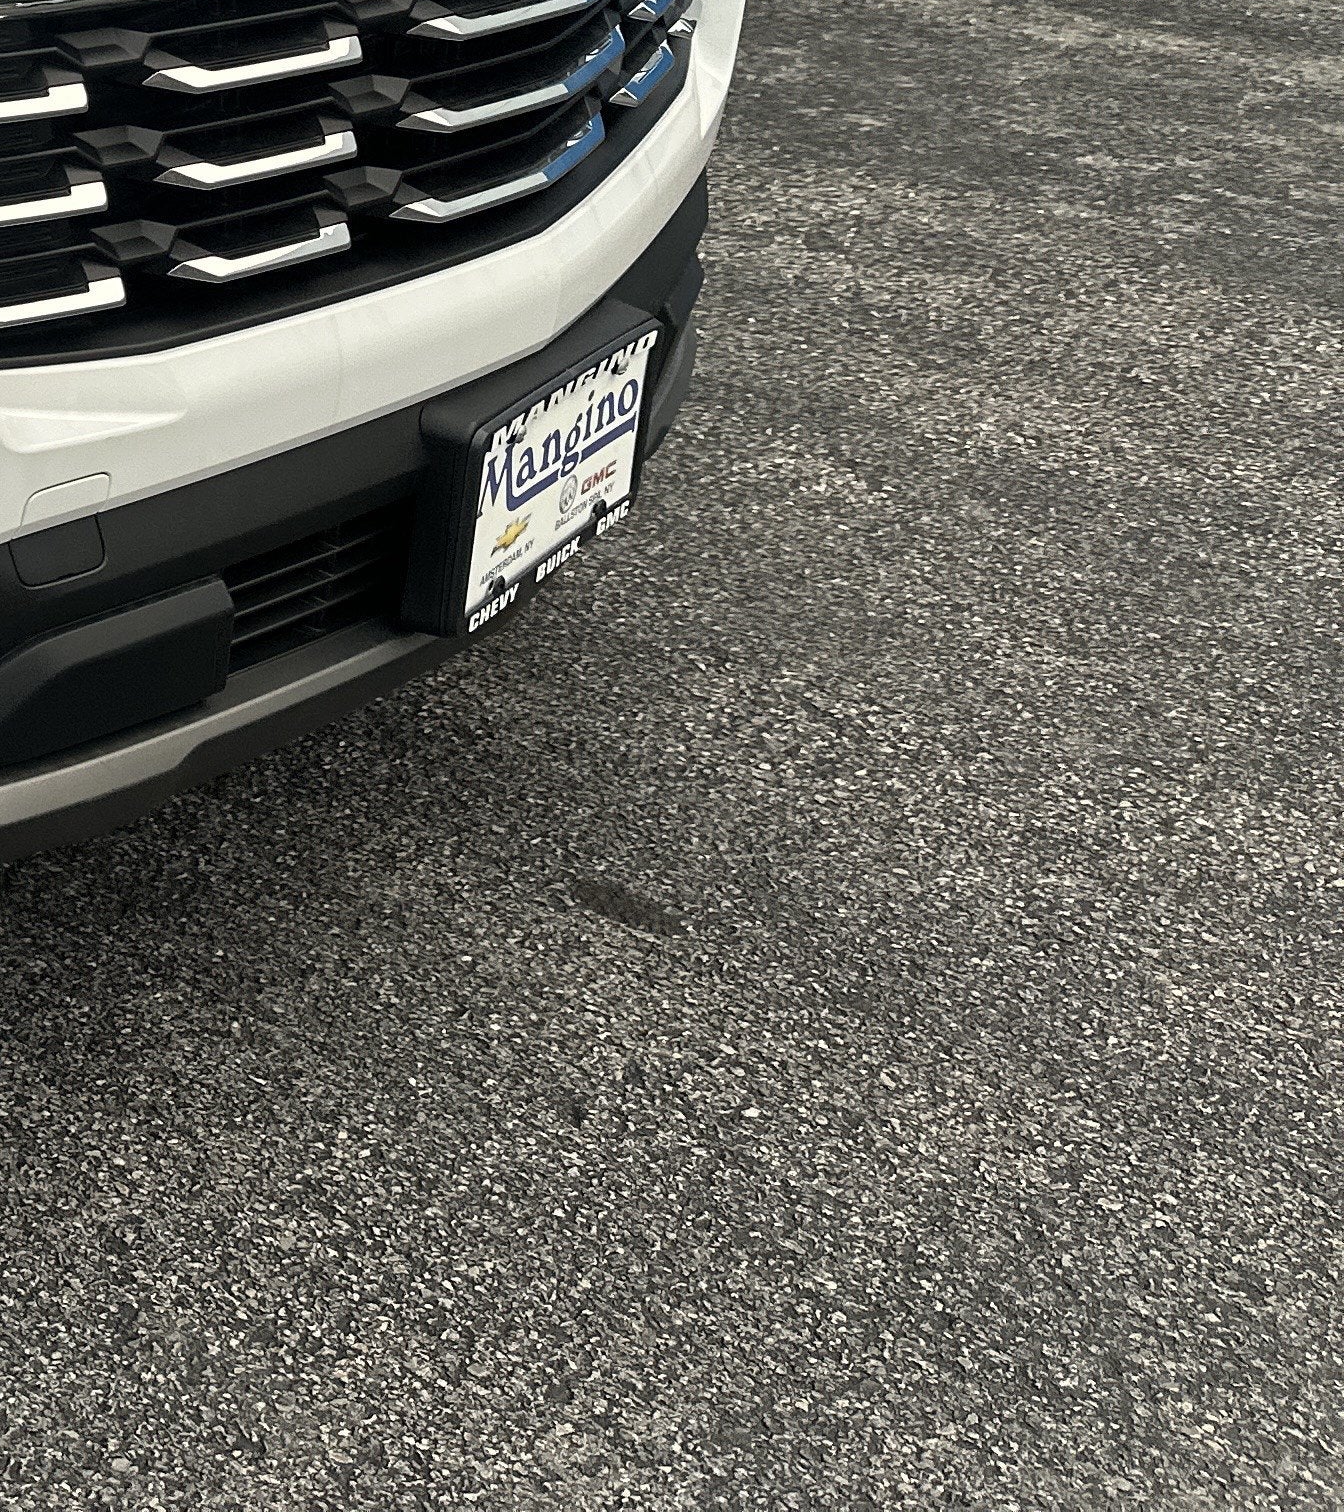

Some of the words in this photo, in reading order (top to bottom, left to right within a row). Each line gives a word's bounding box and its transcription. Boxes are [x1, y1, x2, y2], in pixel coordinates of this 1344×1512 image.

[476, 377, 640, 519] Mangino
[580, 459, 618, 496] GMC
[468, 582, 520, 633] CHEVY
[535, 535, 582, 583] BUICK
[595, 499, 630, 536] GMC
